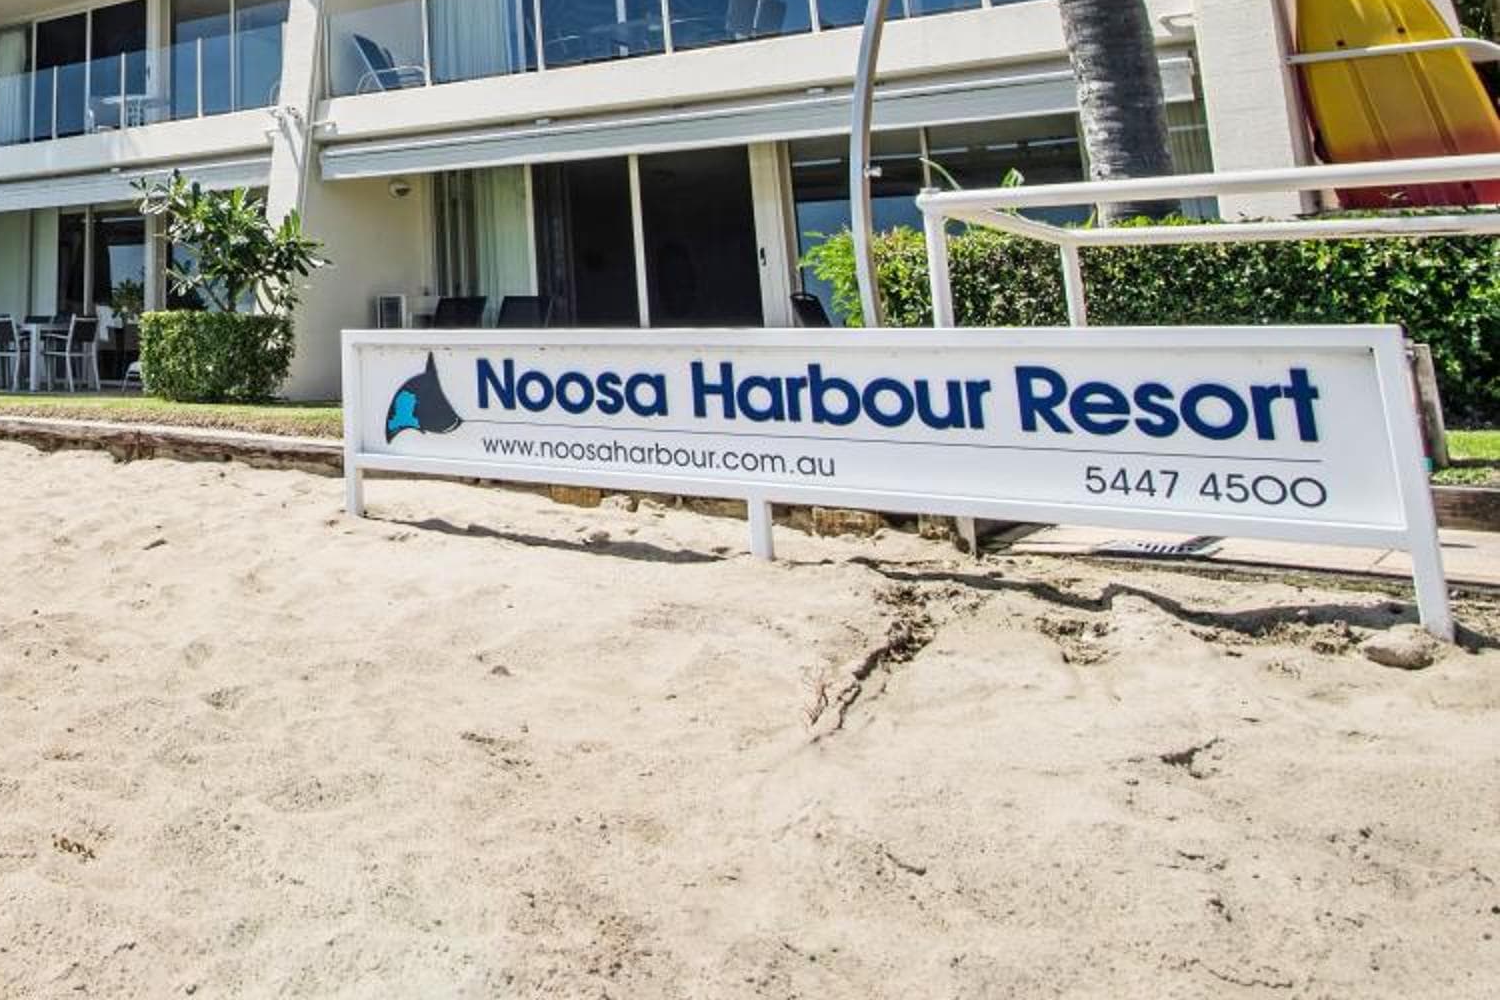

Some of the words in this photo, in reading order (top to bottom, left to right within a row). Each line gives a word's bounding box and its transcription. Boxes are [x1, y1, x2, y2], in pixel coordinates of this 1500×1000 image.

[476, 357, 668, 417] Noosa
[690, 360, 991, 431] Harbour
[1014, 365, 1322, 443] Resort
[482, 438, 836, 477] www.noosaharbour.com.au
[1085, 465, 1180, 498] 5447
[1199, 471, 1329, 508] 4500
